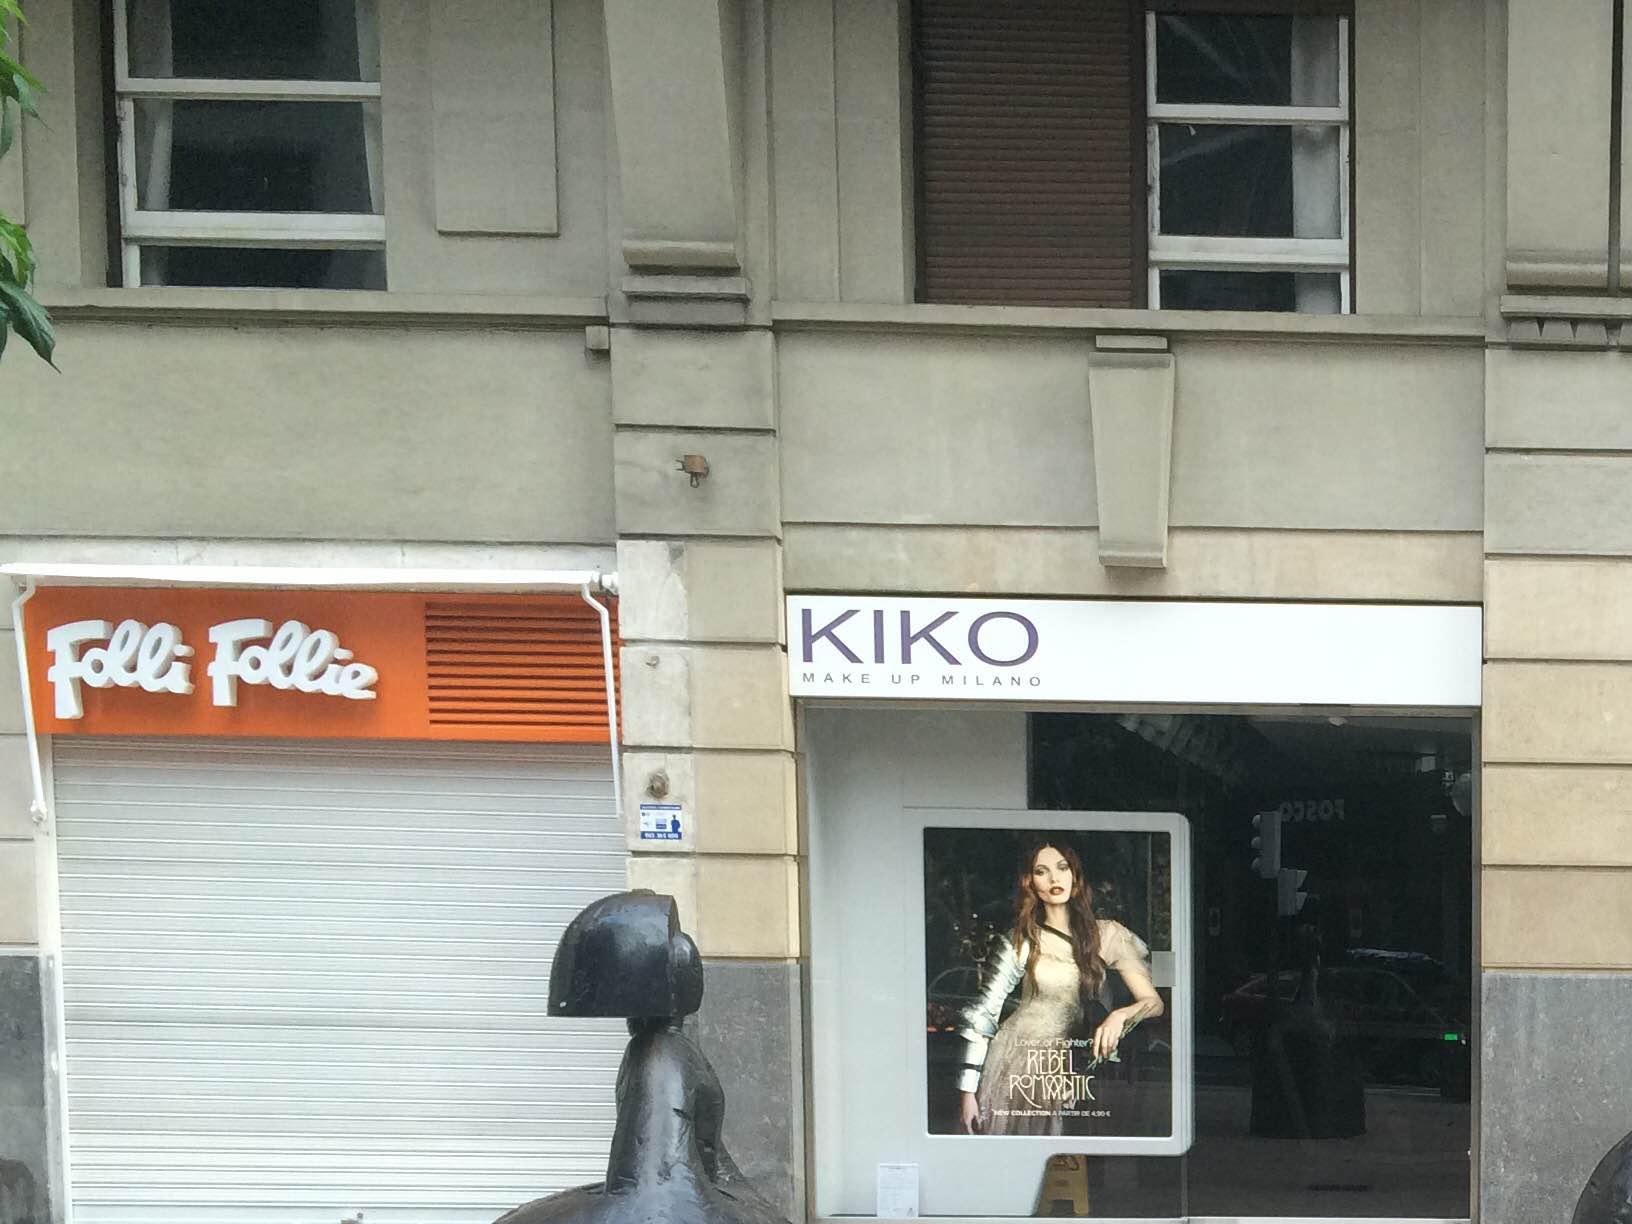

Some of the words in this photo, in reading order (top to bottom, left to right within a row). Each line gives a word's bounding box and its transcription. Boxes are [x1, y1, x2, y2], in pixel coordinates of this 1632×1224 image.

[801, 608, 1039, 667] KIKO
[47, 618, 195, 719] Folli
[206, 618, 378, 707] Follie
[802, 672, 871, 684] MAKE
[891, 674, 920, 685] UP
[942, 674, 1041, 687] MILANO
[1056, 1037, 1094, 1049] Fighter?
[1027, 1049, 1077, 1075] REBEL
